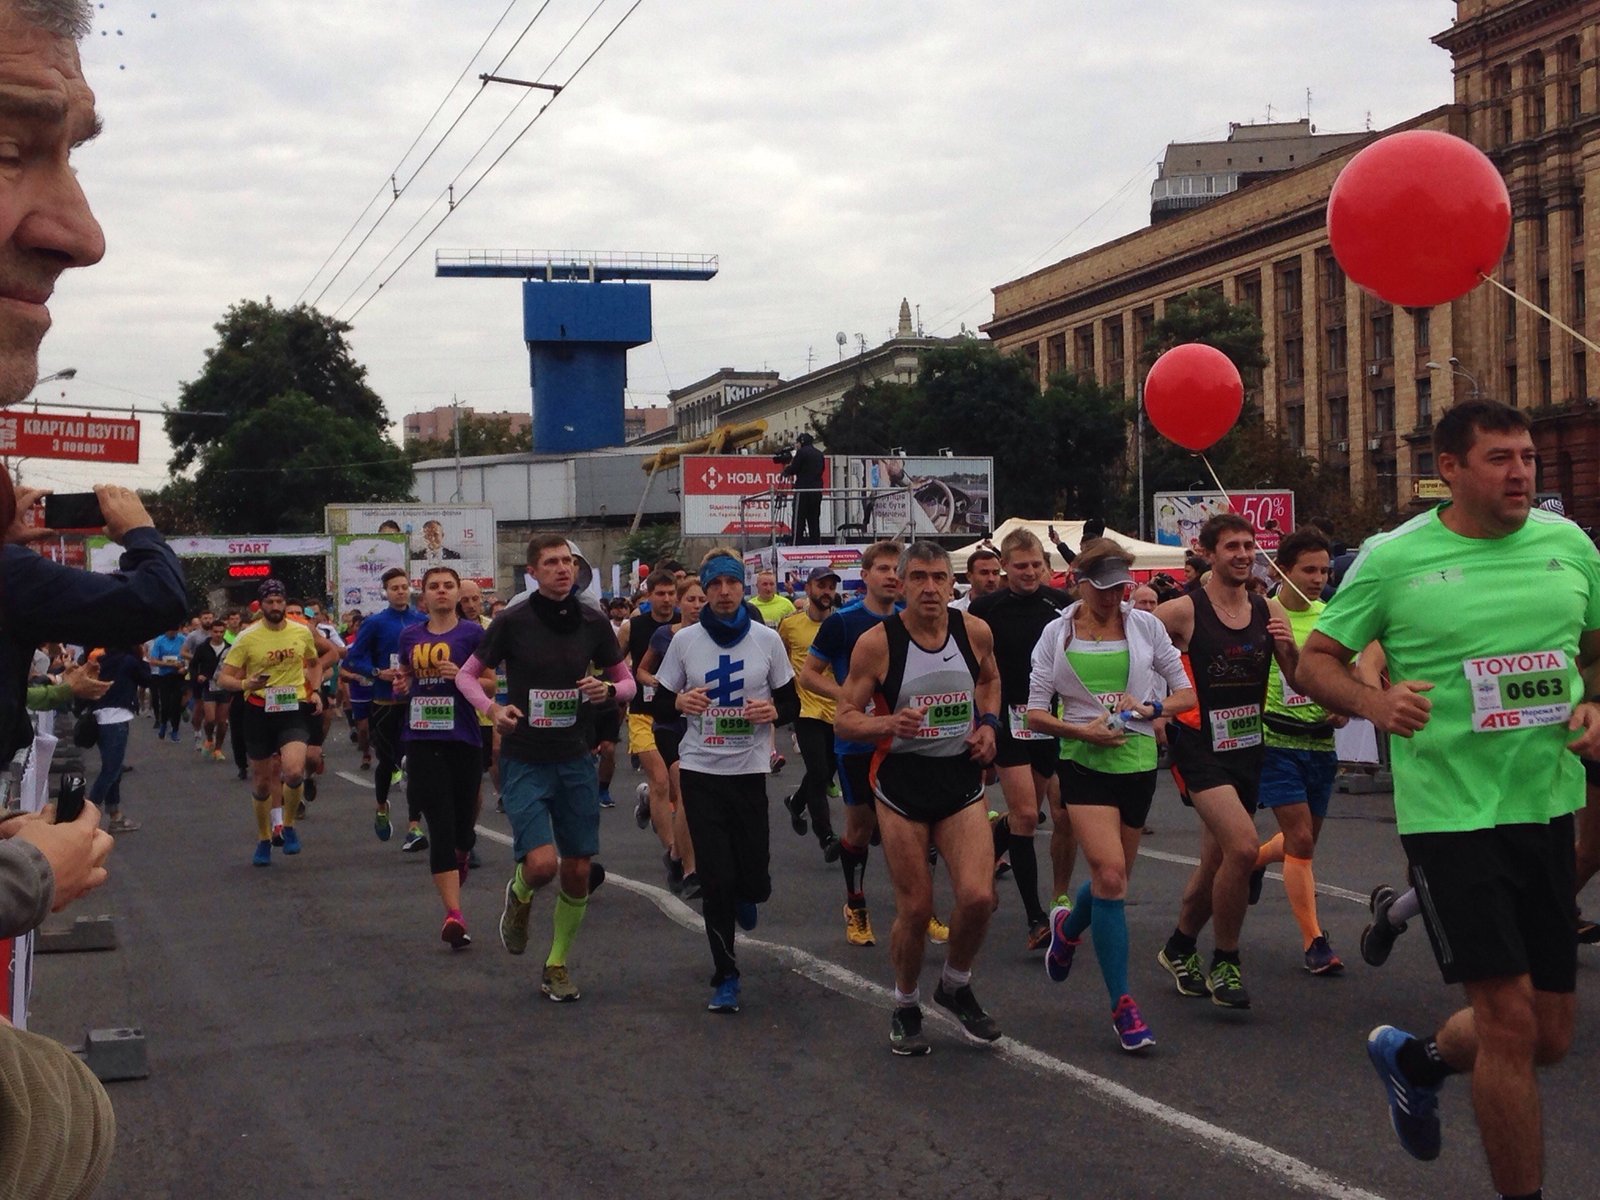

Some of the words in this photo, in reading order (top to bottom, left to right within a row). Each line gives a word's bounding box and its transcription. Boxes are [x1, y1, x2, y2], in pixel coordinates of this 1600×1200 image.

[24, 419, 84, 438] КВАРТАЛ
[87, 422, 135, 441] ВЗУТТЯ
[52, 439, 59, 451] 3
[62, 441, 105, 454] поверх
[727, 473, 762, 484] НОВА
[463, 529, 473, 538] 15
[228, 543, 270, 554] START
[266, 648, 295, 661] 2015
[412, 642, 450, 669] NO
[1472, 653, 1562, 676] TOYOTA
[534, 691, 577, 699] TOYOTA
[1506, 677, 1564, 700] 0663
[413, 698, 451, 706] TOYOTA
[916, 692, 968, 706] TOYOTA
[1097, 693, 1124, 705] YOT
[934, 703, 968, 718] 0582
[1214, 705, 1257, 720] TOYOTA
[1231, 716, 1258, 730] 0057
[1480, 710, 1521, 729] АТБ
[703, 736, 725, 745] АТБ
[1217, 738, 1238, 749] АТБ
